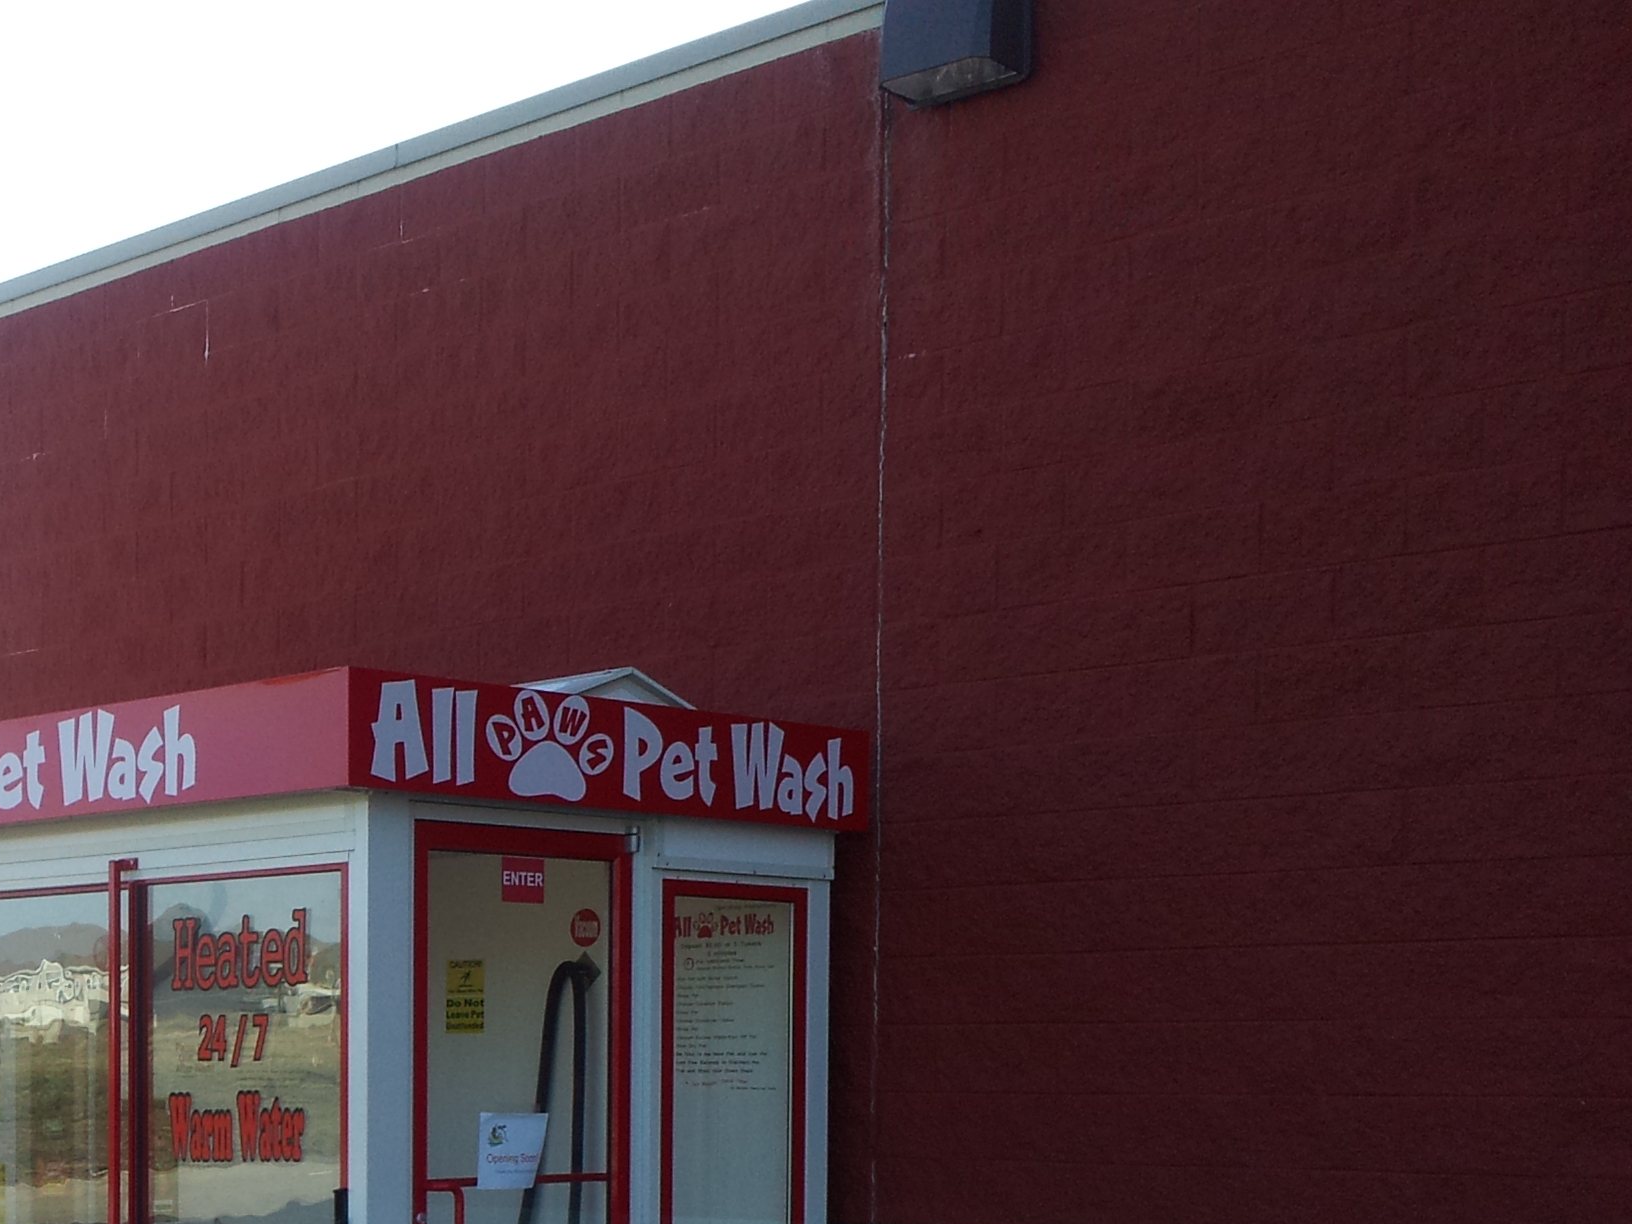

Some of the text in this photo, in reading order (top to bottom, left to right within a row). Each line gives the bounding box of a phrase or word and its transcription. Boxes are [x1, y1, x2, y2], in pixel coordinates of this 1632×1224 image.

[57, 704, 198, 807] Wash
[371, 679, 855, 823] All PAWS Pet Wash
[503, 871, 543, 887] ENTER
[171, 907, 309, 991] Heated
[720, 914, 743, 936] Pet
[744, 913, 775, 936] Wash
[446, 999, 484, 1007] Do Not
[169, 1090, 305, 1162] Warm Water
